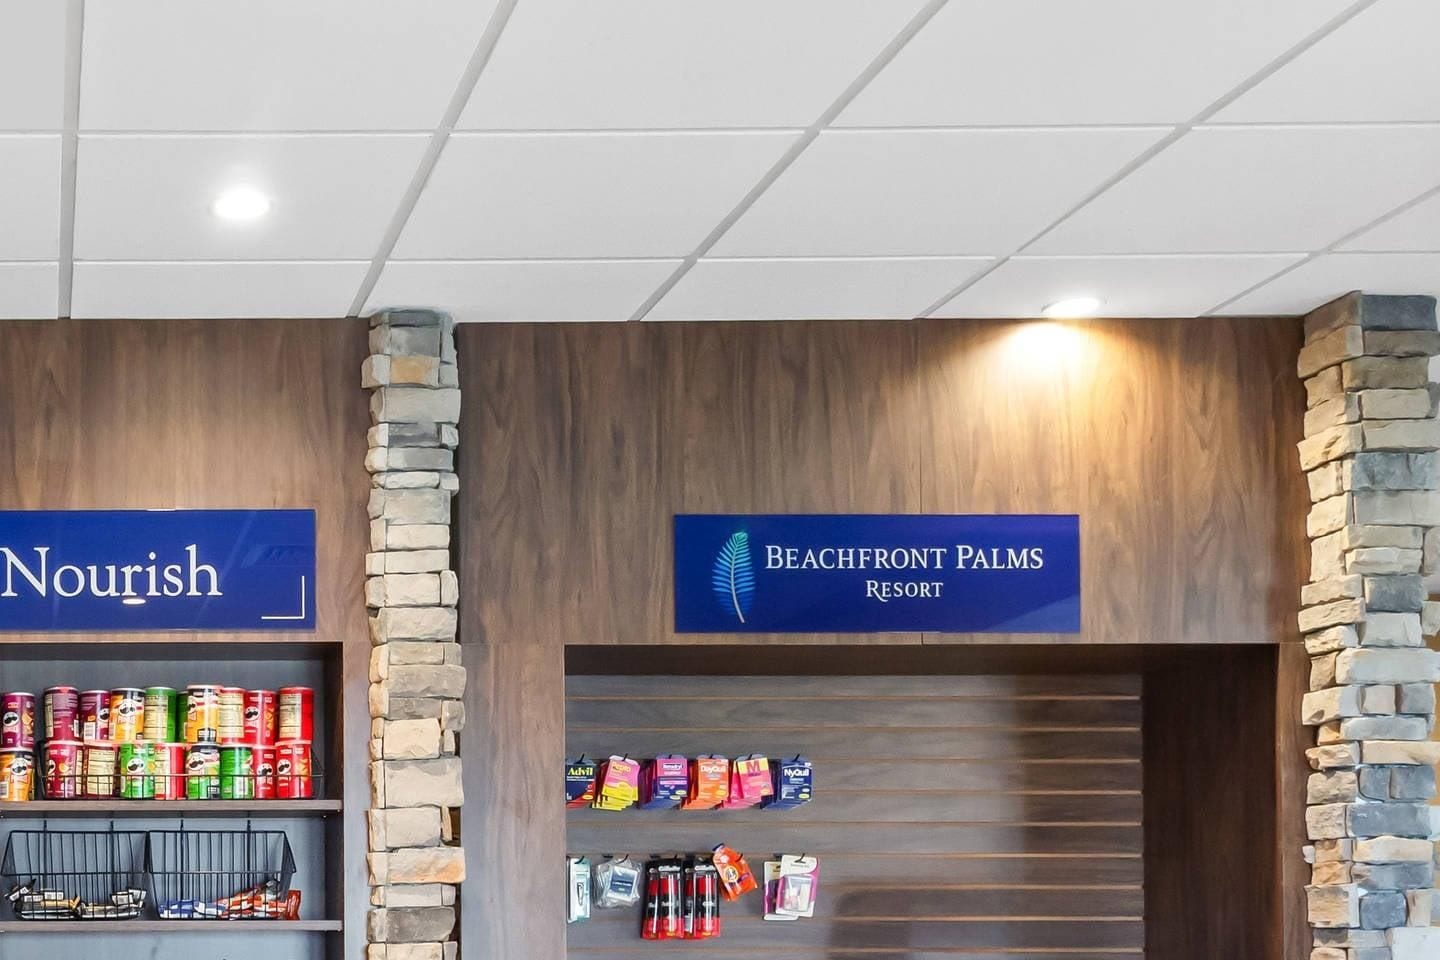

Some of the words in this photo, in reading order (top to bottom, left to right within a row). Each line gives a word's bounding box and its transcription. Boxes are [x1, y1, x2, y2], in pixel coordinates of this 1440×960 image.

[765, 545, 947, 570] BEACHFRONT
[956, 545, 1044, 570] PALMS
[0, 544, 223, 597] Nourish
[865, 580, 944, 601] RESORT
[567, 767, 593, 776] Advil
[784, 769, 810, 778] NyQuil
